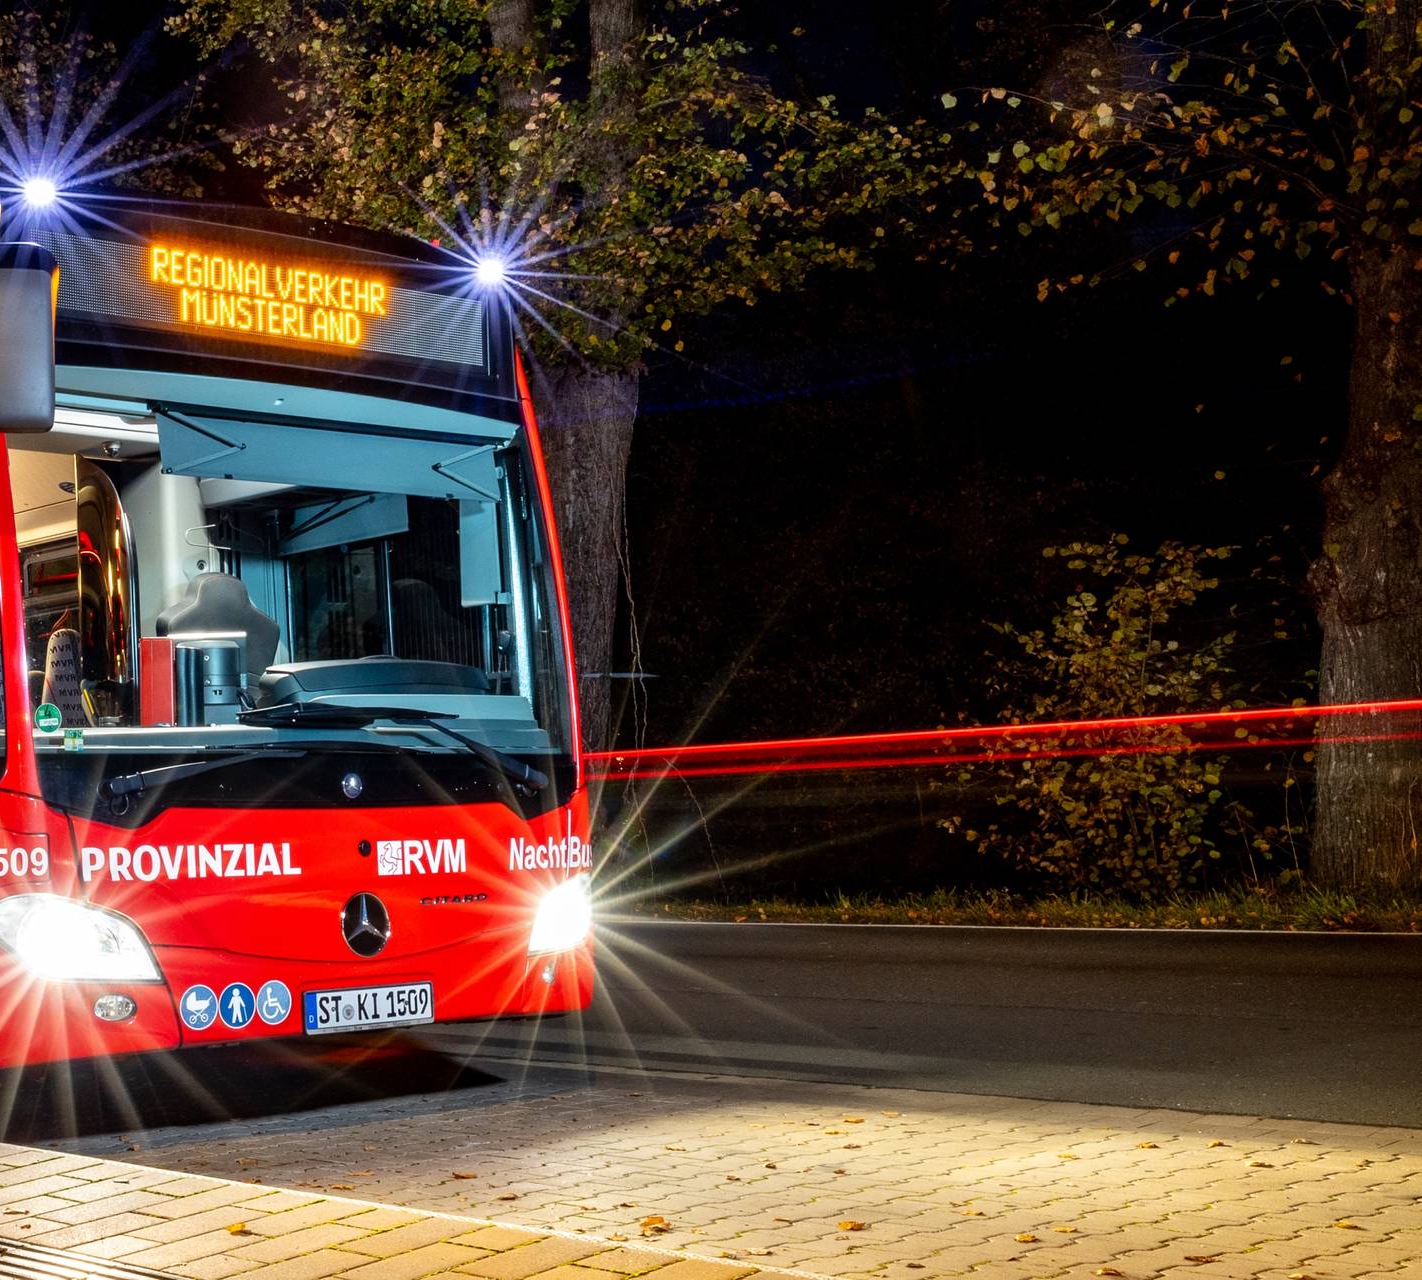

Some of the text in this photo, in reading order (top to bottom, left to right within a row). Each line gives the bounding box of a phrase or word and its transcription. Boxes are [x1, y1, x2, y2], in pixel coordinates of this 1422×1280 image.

[151, 246, 387, 315] REGIONALVERKEHR
[181, 288, 361, 345] MÜNSTERLAND
[81, 842, 302, 882] PROVINZIAL
[403, 838, 467, 875] RVM
[318, 988, 429, 1024] ST KI 1509
